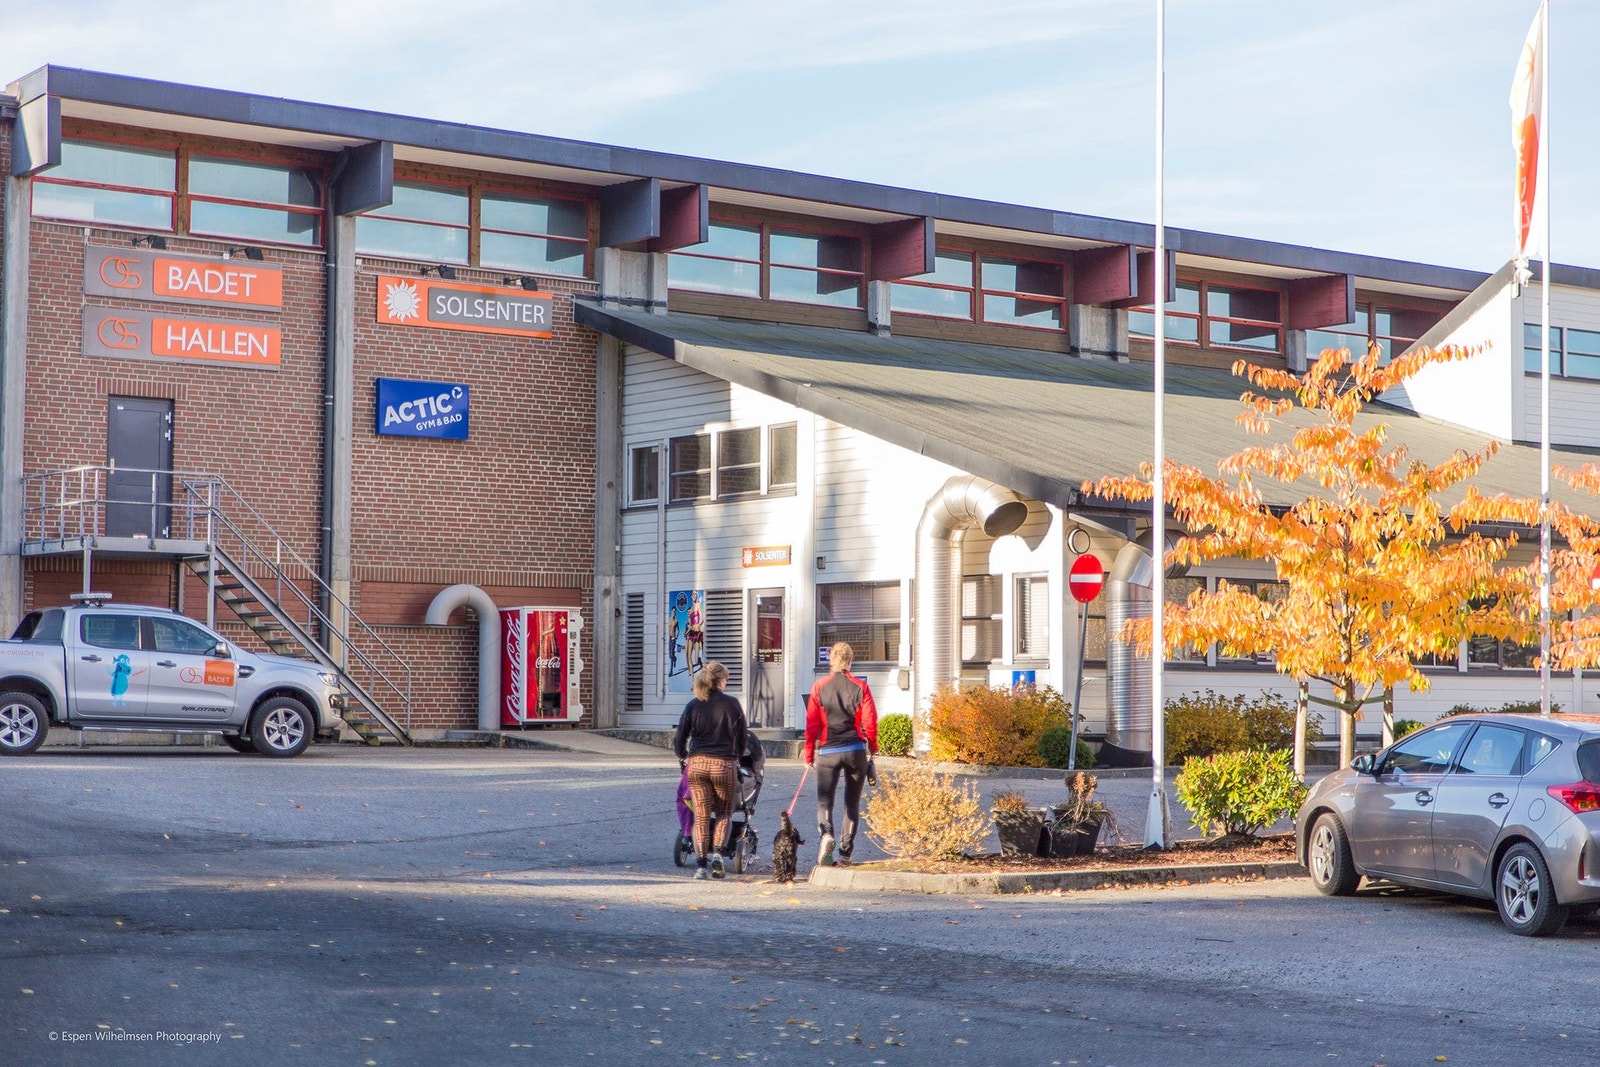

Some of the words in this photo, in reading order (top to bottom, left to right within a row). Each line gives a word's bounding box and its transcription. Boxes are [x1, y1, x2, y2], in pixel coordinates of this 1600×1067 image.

[168, 266, 257, 297] BADET
[436, 295, 545, 325] SOLSENTER
[166, 325, 268, 358] HALLEN
[384, 393, 453, 427] ACTIC
[755, 549, 787, 561] SOLSENTER
[207, 675, 230, 684] BADET
[181, 704, 228, 714] WILDTRAK
